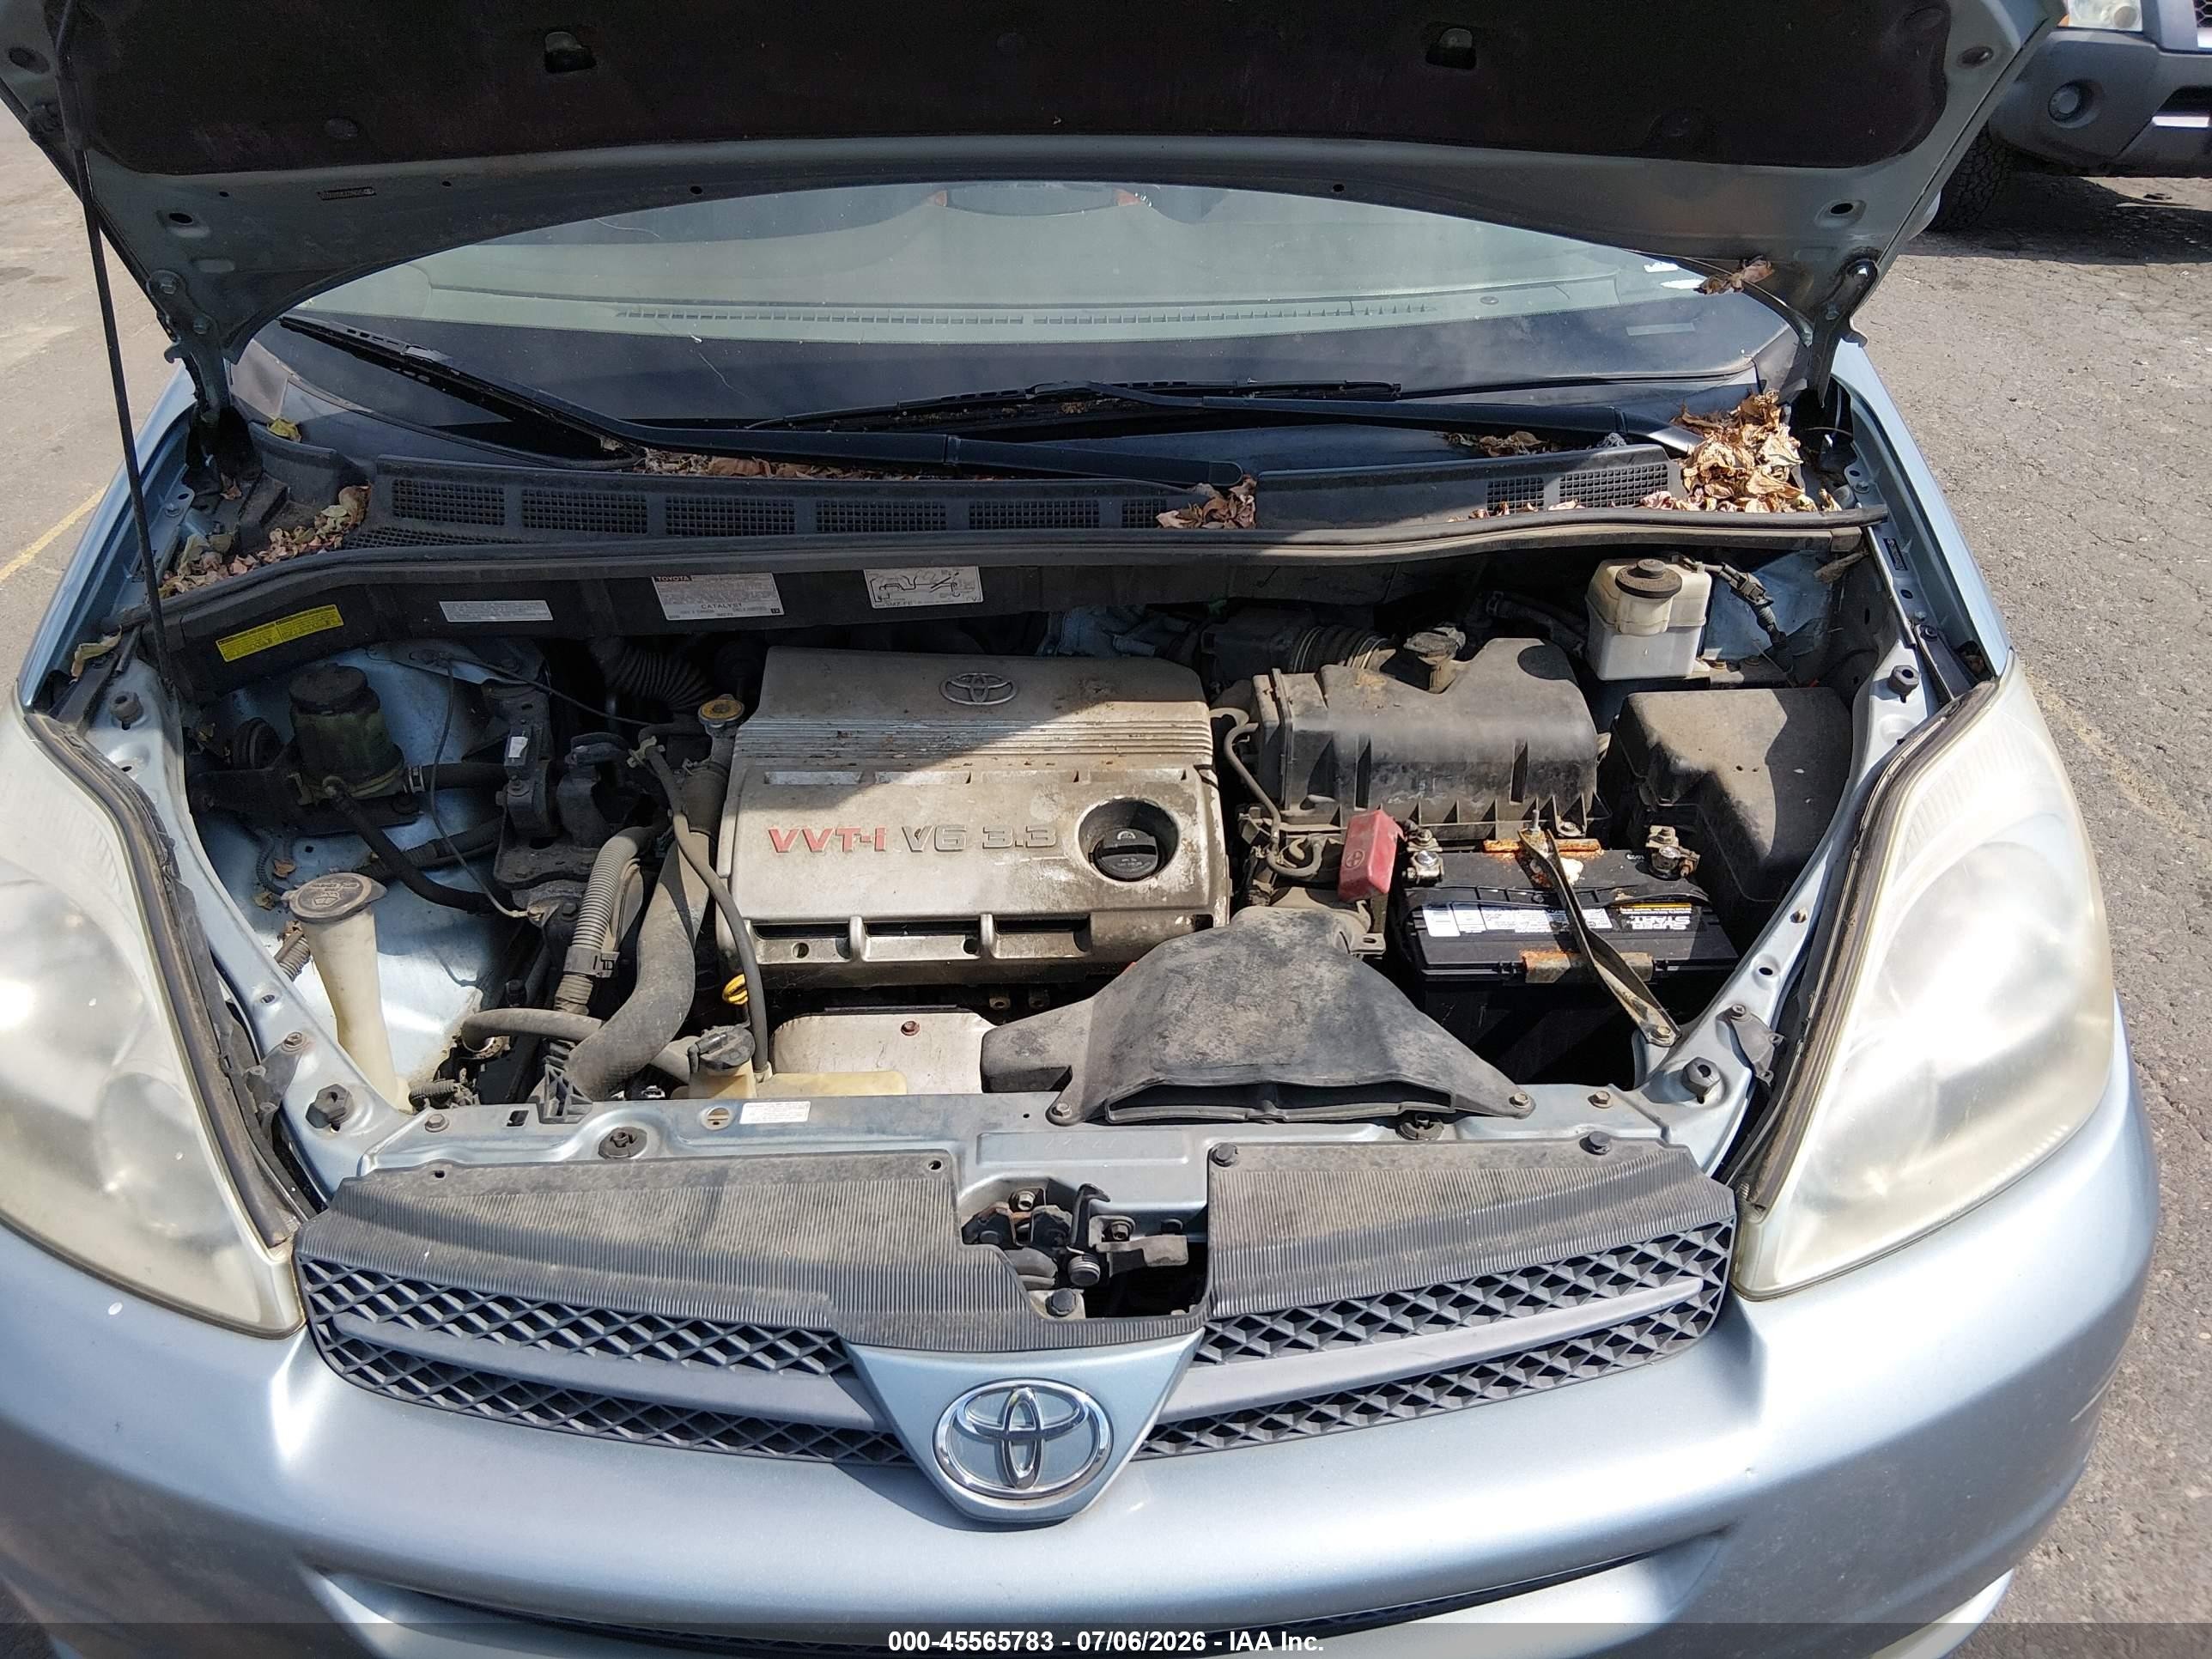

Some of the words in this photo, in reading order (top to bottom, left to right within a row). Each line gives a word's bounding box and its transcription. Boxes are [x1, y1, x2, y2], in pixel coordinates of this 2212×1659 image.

[901, 824, 969, 852] V6
[981, 823, 1057, 849] 3.3
[1630, 915, 1691, 924] START
[1632, 921, 1688, 930] SUPER
